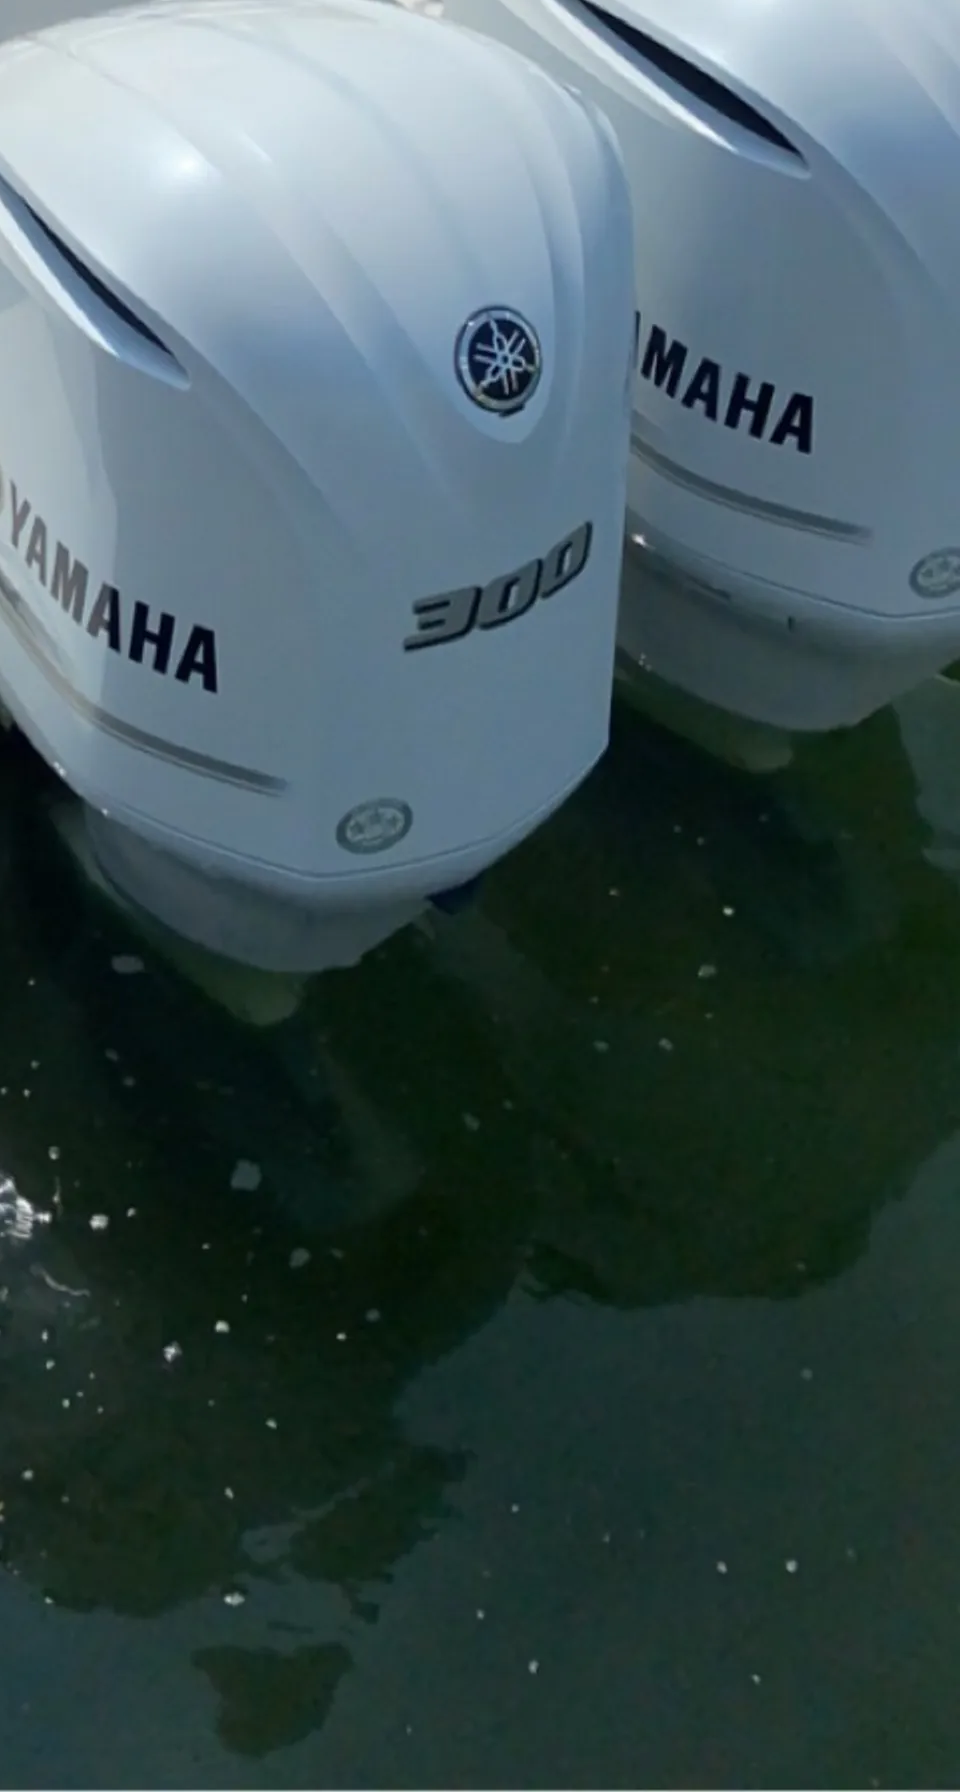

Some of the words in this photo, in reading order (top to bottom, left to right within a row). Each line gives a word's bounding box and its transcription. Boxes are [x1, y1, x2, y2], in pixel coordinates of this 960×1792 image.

[635, 310, 814, 455] MAHA
[10, 479, 218, 694] YAMAHA
[403, 521, 593, 652] 300
